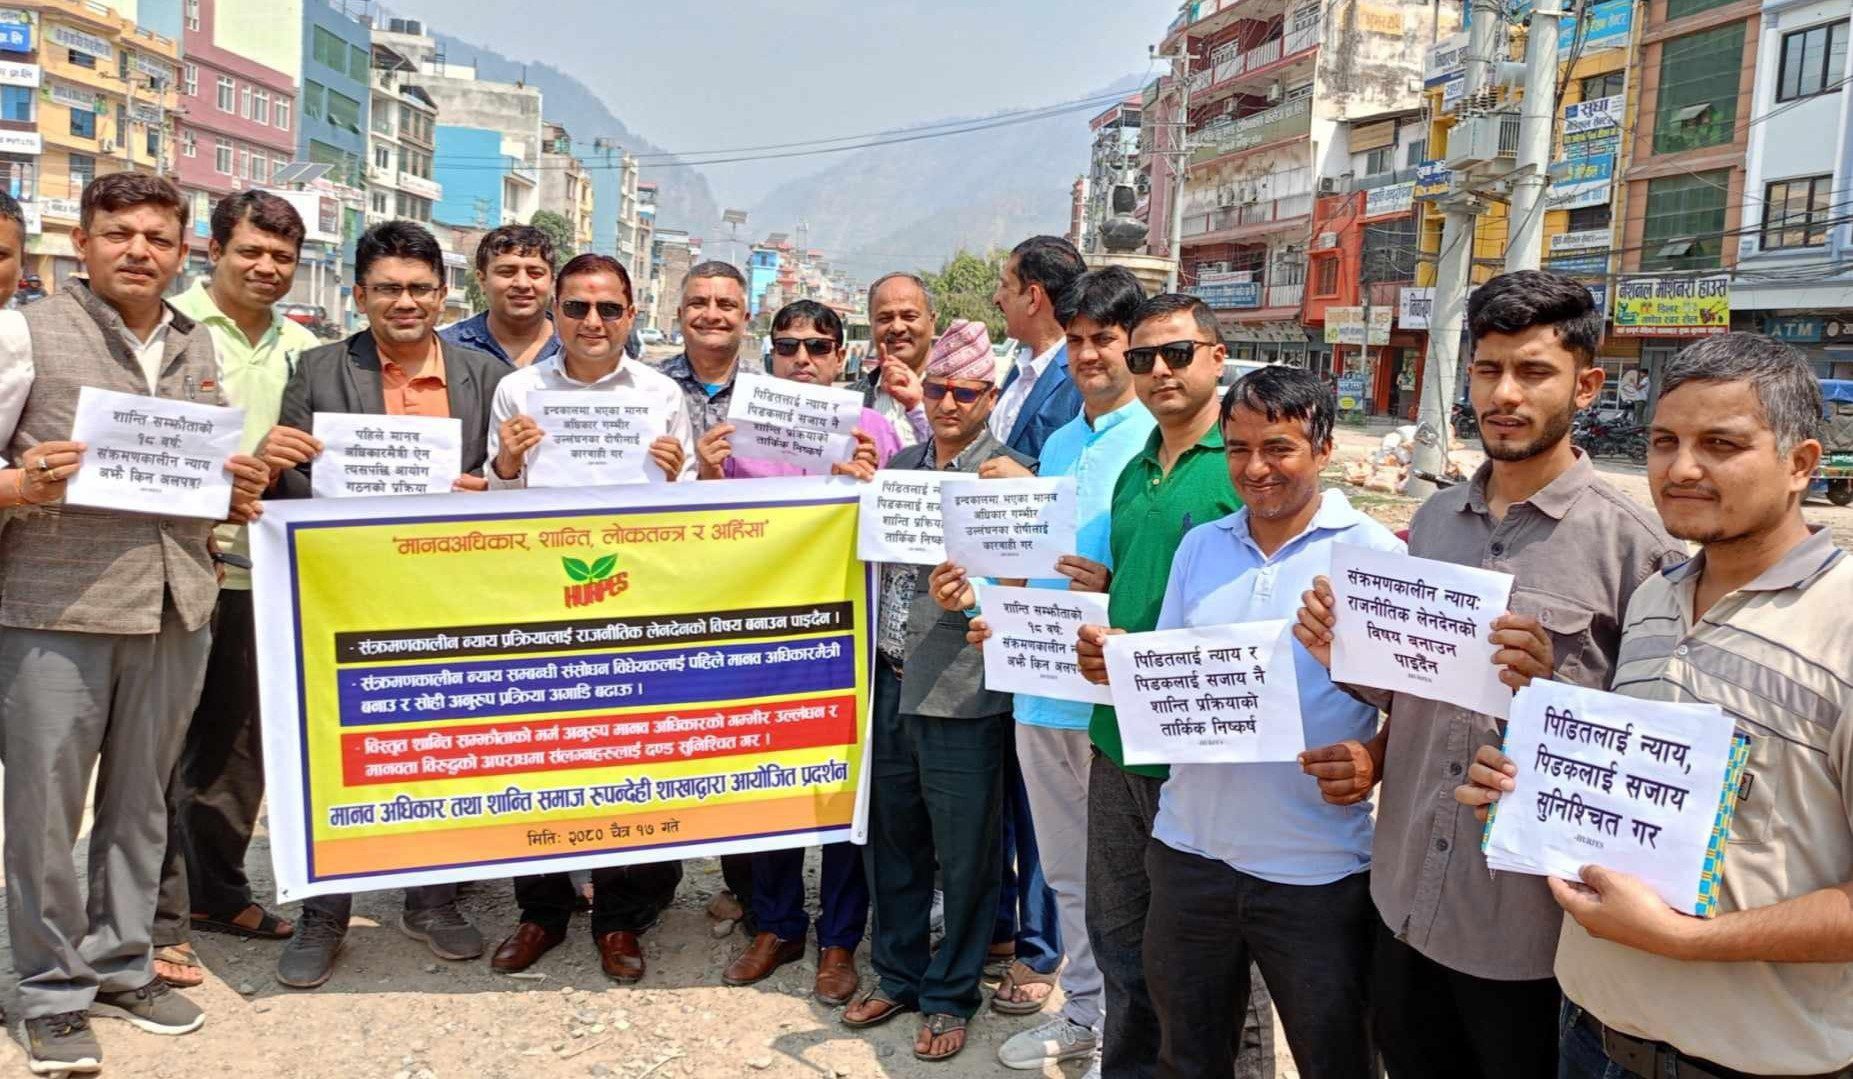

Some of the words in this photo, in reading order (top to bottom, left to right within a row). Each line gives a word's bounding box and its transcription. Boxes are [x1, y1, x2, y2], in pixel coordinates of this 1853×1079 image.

[1699, 279, 1727, 298] हाउस
[1771, 322, 1813, 336] ATM
[594, 406, 620, 416] भएका
[624, 406, 648, 415] मानव
[806, 398, 828, 410] न्याय
[832, 403, 840, 413] र
[113, 409, 148, 426] शान्ति
[152, 415, 214, 434] सम्झौताको
[564, 418, 598, 429] अधिकार
[602, 418, 630, 430] गम्भीर
[754, 422, 781, 435] शान्ति
[798, 413, 828, 428] सजाय
[137, 433, 155, 446] १८
[355, 427, 385, 441] पहिले
[390, 431, 420, 443] मानव
[97, 447, 179, 468] संक्रमणकालीन
[184, 458, 212, 471] न्याय
[344, 443, 408, 459] अधिकारमैत्री
[413, 448, 430, 460] ऐन
[610, 450, 623, 459] गर
[129, 467, 154, 485] किन
[344, 464, 390, 477] त्यसपछि
[395, 463, 430, 477] आयोग
[346, 480, 386, 493] गठनको
[392, 480, 428, 494] प्रक्रिया
[882, 481, 928, 496] पिडितलाई
[877, 496, 922, 512] पिडकलाई
[1004, 494, 1028, 506] भएका
[1033, 492, 1057, 503] मानव
[882, 514, 909, 528] शान्ति
[974, 509, 1007, 520] अधिकार
[1011, 508, 1038, 519] गम्भीर
[538, 526, 595, 552] शान्ति,
[602, 523, 686, 545] लोकतन्त्र
[692, 524, 706, 541] र
[885, 529, 917, 543] तार्किक
[1013, 522, 1048, 535] दोषीलाई
[1020, 540, 1033, 550] गर
[1347, 567, 1439, 601] संक्रमणकालीन
[1003, 600, 1029, 615] शान्ति
[1033, 603, 1082, 621] सम्झौताको
[1347, 595, 1411, 623] राजनीतिक
[1416, 607, 1478, 639] लेनदेनको
[358, 633, 459, 656] संक्रमणकालीन
[462, 634, 498, 649] न्याय
[501, 627, 573, 649] प्रक्रियालाई
[575, 623, 642, 643] राजनीतिक
[646, 618, 707, 639] लेनदेनको
[710, 617, 743, 633] विषय
[745, 615, 788, 631] बनाउन
[1028, 621, 1042, 634] १८
[1002, 636, 1067, 654] संक्रमणकालीन
[1366, 620, 1402, 645] विषय
[1407, 634, 1457, 657] बनाउन
[1030, 655, 1050, 671] किन
[1134, 645, 1201, 669] पिडितलाई
[1207, 647, 1242, 663] न्याय
[1248, 646, 1259, 660] र
[360, 670, 464, 692] संक्रमणकालीन
[466, 669, 503, 684] न्याय
[506, 663, 558, 682] सम्बन्धी
[613, 656, 685, 675] विधेयकलाई
[689, 651, 725, 669] पहिले
[727, 653, 761, 667] मानव
[765, 641, 841, 664] अधिकारमैत्री
[1134, 670, 1200, 692] पिडकलाई
[1205, 671, 1247, 688] सजाय
[1253, 665, 1266, 685] नै
[361, 698, 396, 715] बनाउ
[401, 699, 412, 712] र
[415, 693, 445, 711] सोही
[499, 687, 545, 706] प्रक्रिया
[549, 683, 592, 701] अगाडि
[1150, 696, 1190, 714] शान्ति
[1195, 691, 1259, 712] प्रक्रियाको
[364, 737, 408, 755] विस्तृत
[411, 733, 453, 750] शान्ति
[535, 725, 559, 742] मर्म
[612, 722, 650, 736] मानव
[653, 714, 725, 733] अधिकारको
[727, 709, 770, 727] गम्भीर
[828, 704, 839, 717] र
[1160, 718, 1206, 737] तार्किक
[1212, 714, 1257, 735] निष्कर्ष
[1543, 705, 1634, 756] पिडितलाई
[1640, 733, 1692, 776] न्याय,
[364, 761, 418, 777] मानवता
[481, 751, 545, 769] अपराधमा
[645, 742, 674, 756] दण्ड
[739, 733, 761, 748] गर
[1533, 743, 1618, 795] पिडकलाई
[1624, 773, 1689, 814] सजाय
[329, 803, 375, 827] मानव
[380, 795, 447, 824] अधिकार
[451, 795, 482, 818] तथा
[487, 787, 533, 815] शान्ति
[537, 787, 585, 809] समाज
[656, 774, 726, 799] शाखाद्वारा
[731, 764, 797, 791] आयोजित
[802, 759, 848, 787] प्रदर्शन
[1536, 787, 1624, 839] सुनिश्चित
[1631, 819, 1662, 850] गर
[569, 828, 603, 846] २०८०
[610, 822, 631, 838] चैत्र
[636, 823, 655, 837] १७
[661, 818, 680, 833] गते
